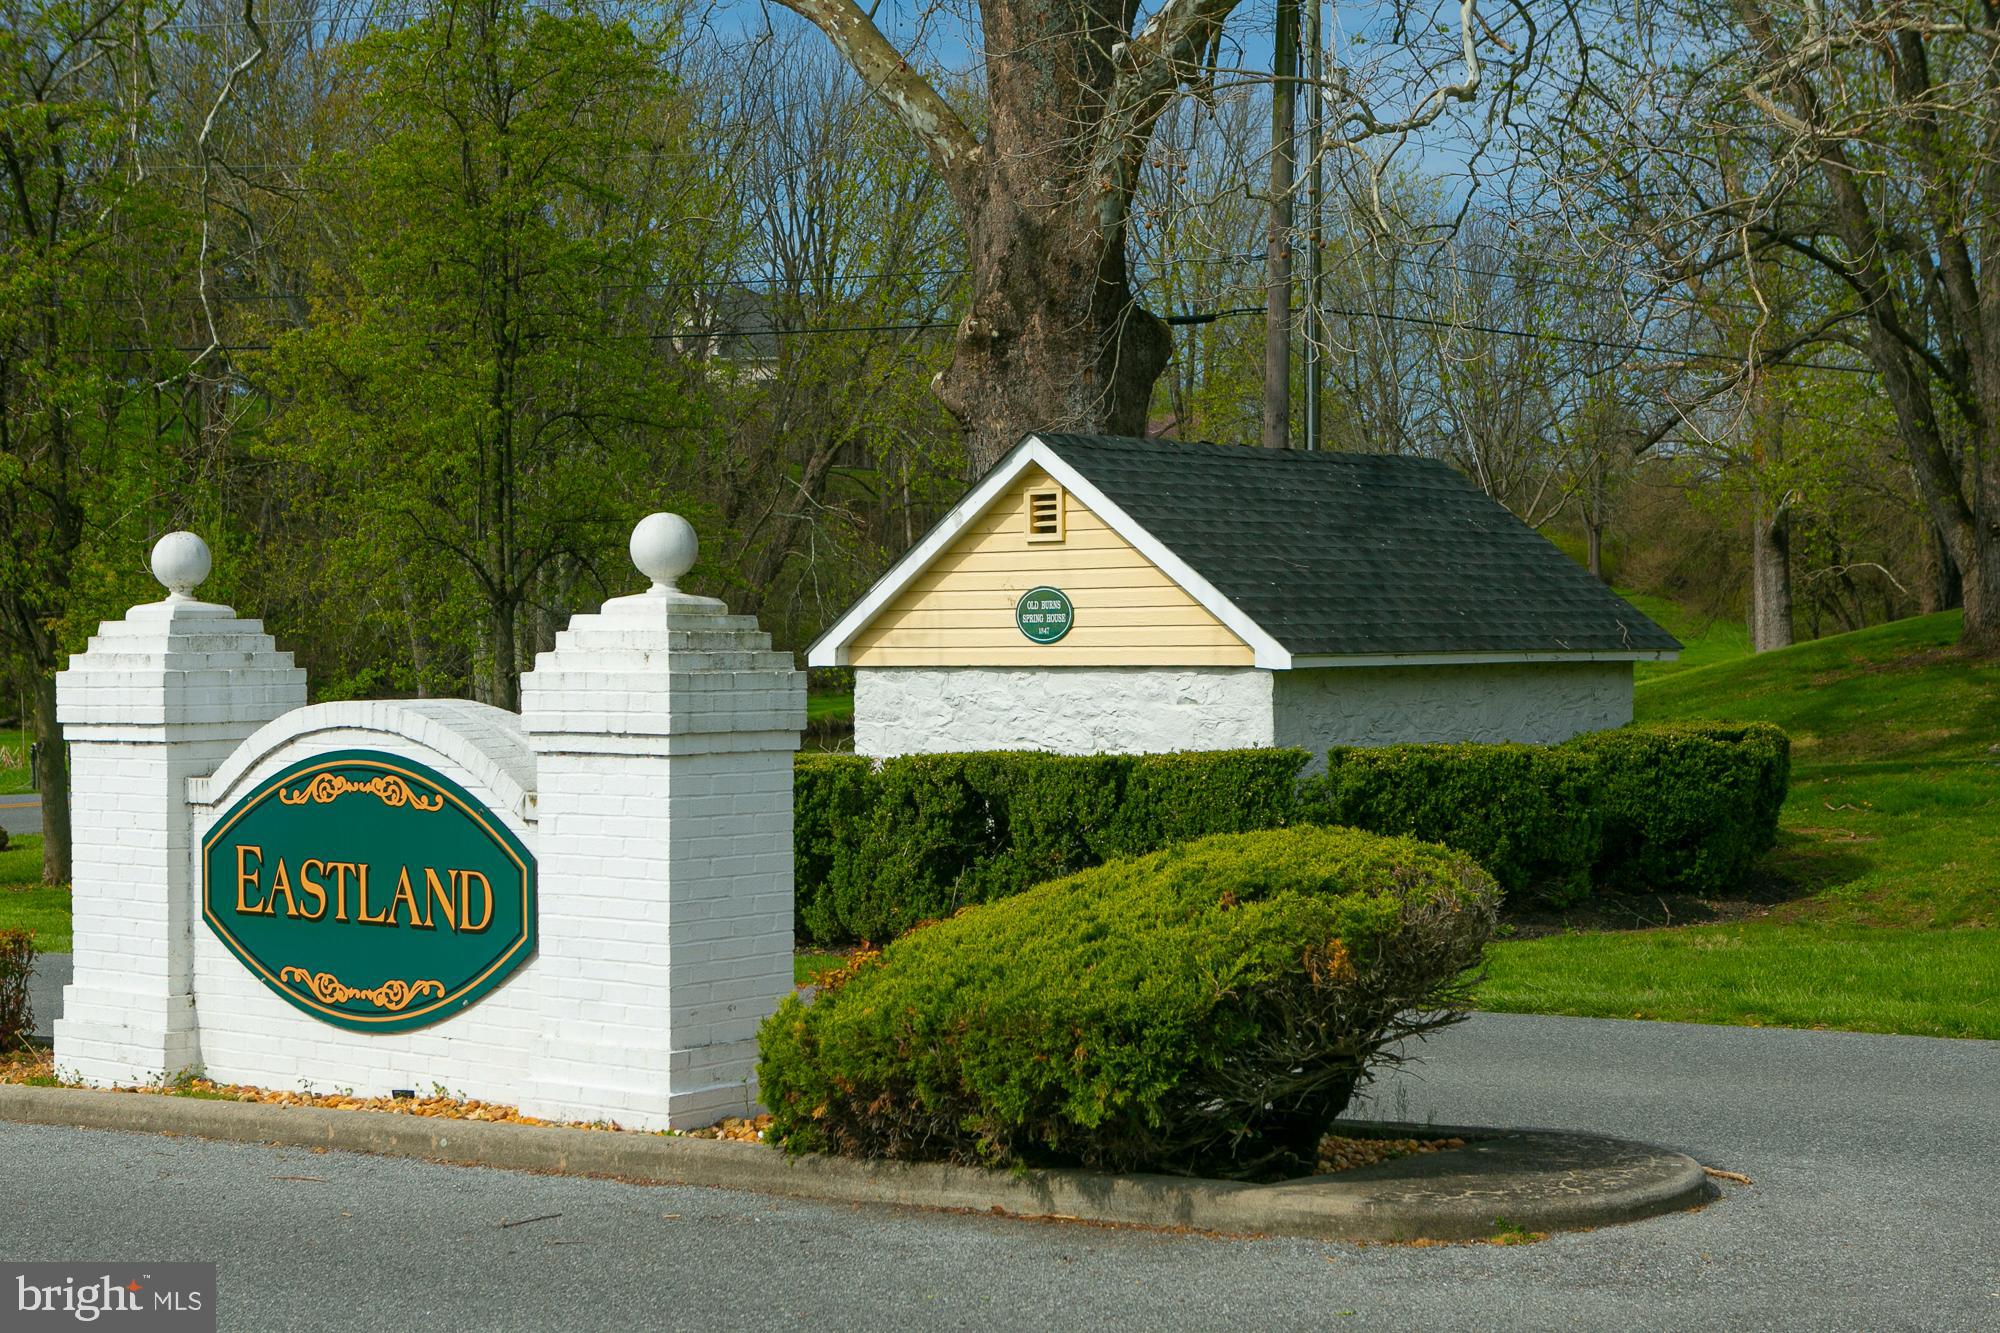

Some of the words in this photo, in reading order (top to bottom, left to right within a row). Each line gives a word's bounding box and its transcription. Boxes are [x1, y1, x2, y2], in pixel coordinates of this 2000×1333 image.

[1027, 601, 1039, 609] OLD
[1022, 614, 1044, 623] SPRING
[1046, 614, 1066, 623] HOUSE
[235, 845, 494, 932] EASTLAND
